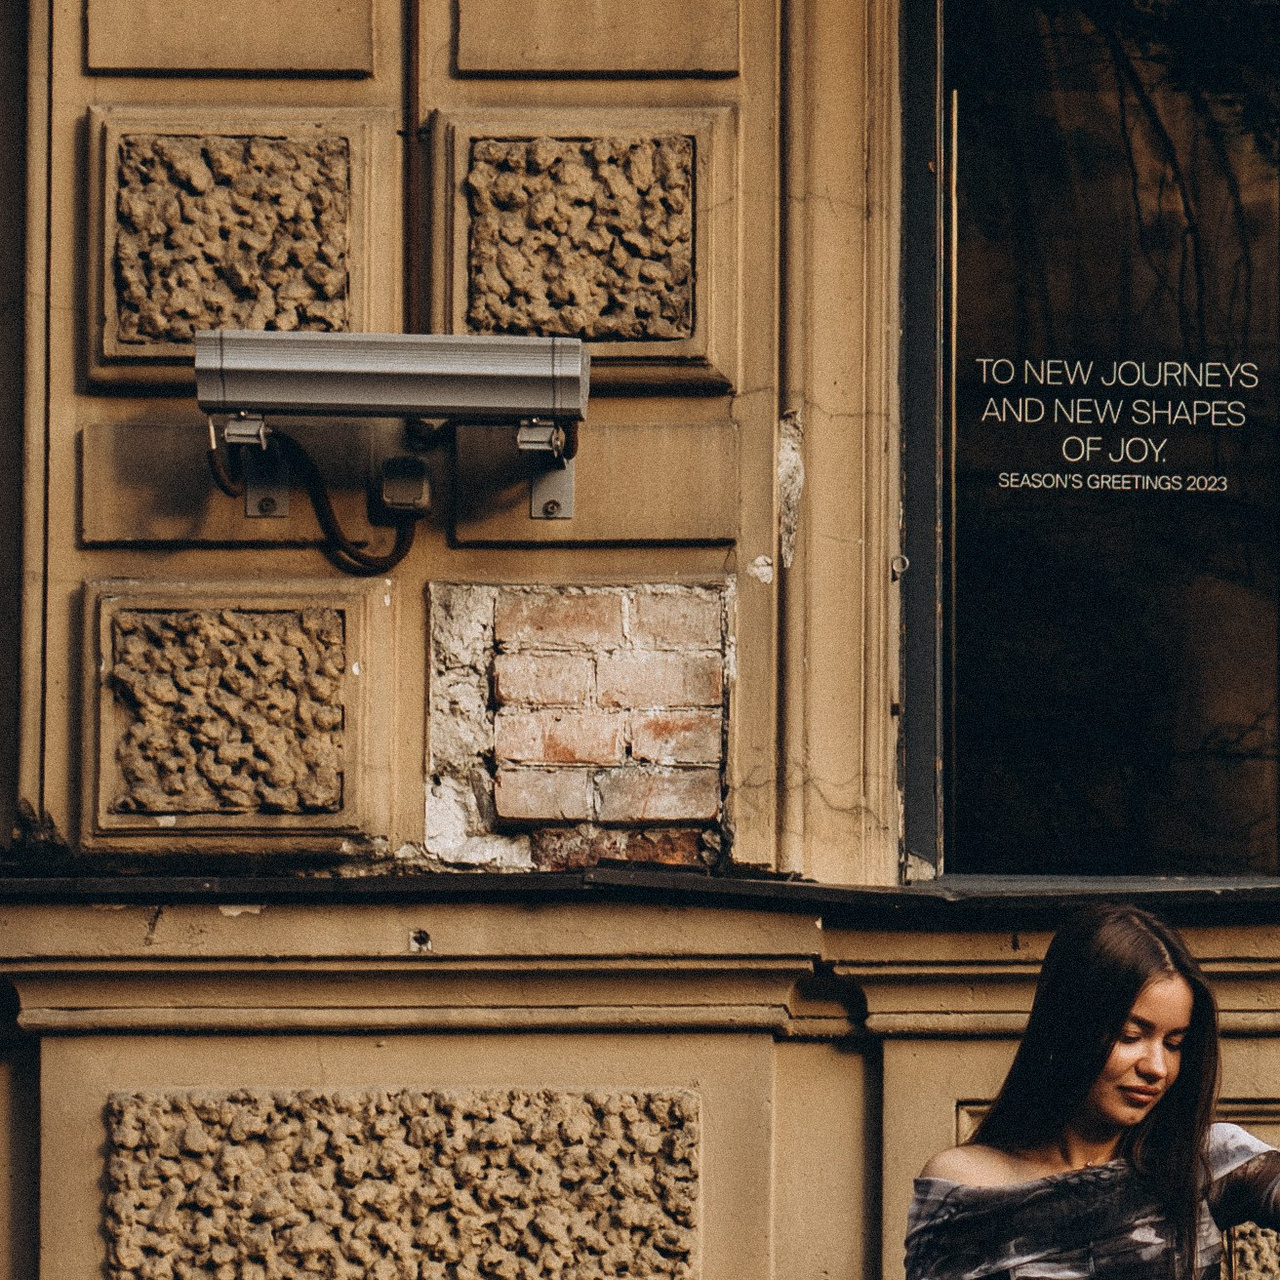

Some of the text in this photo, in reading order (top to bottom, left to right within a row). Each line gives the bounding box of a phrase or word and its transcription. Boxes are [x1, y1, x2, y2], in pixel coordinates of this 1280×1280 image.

[975, 358, 1259, 389] TO NEW JOURNEYS
[981, 397, 1246, 427] AND NEW SHAPES
[1061, 435, 1168, 464] OF JOY.
[998, 472, 1228, 492] SEASON'S GREETINGS 2023
